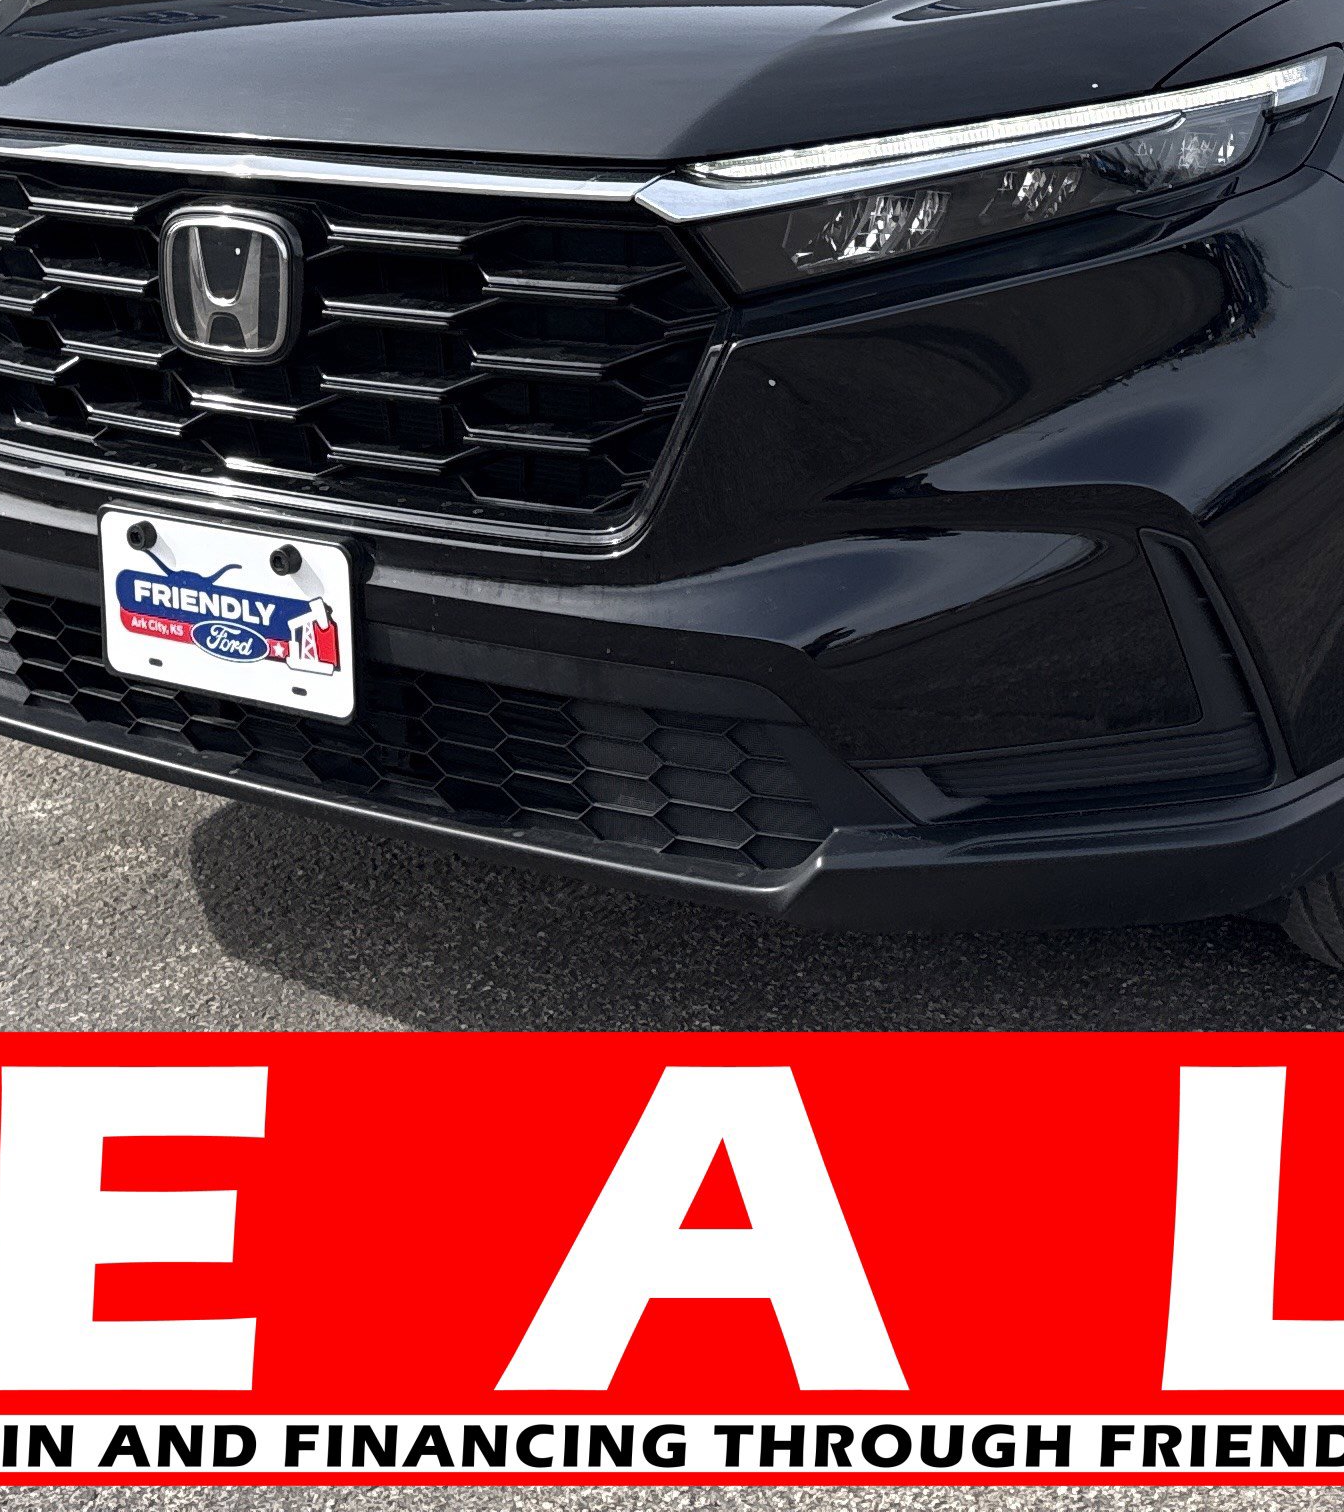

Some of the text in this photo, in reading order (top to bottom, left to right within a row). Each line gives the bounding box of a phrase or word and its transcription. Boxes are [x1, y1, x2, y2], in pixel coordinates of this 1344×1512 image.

[133, 579, 276, 627] FRIENDLY
[131, 615, 148, 631] Ark
[169, 621, 184, 637] KS
[206, 624, 253, 656] Ford
